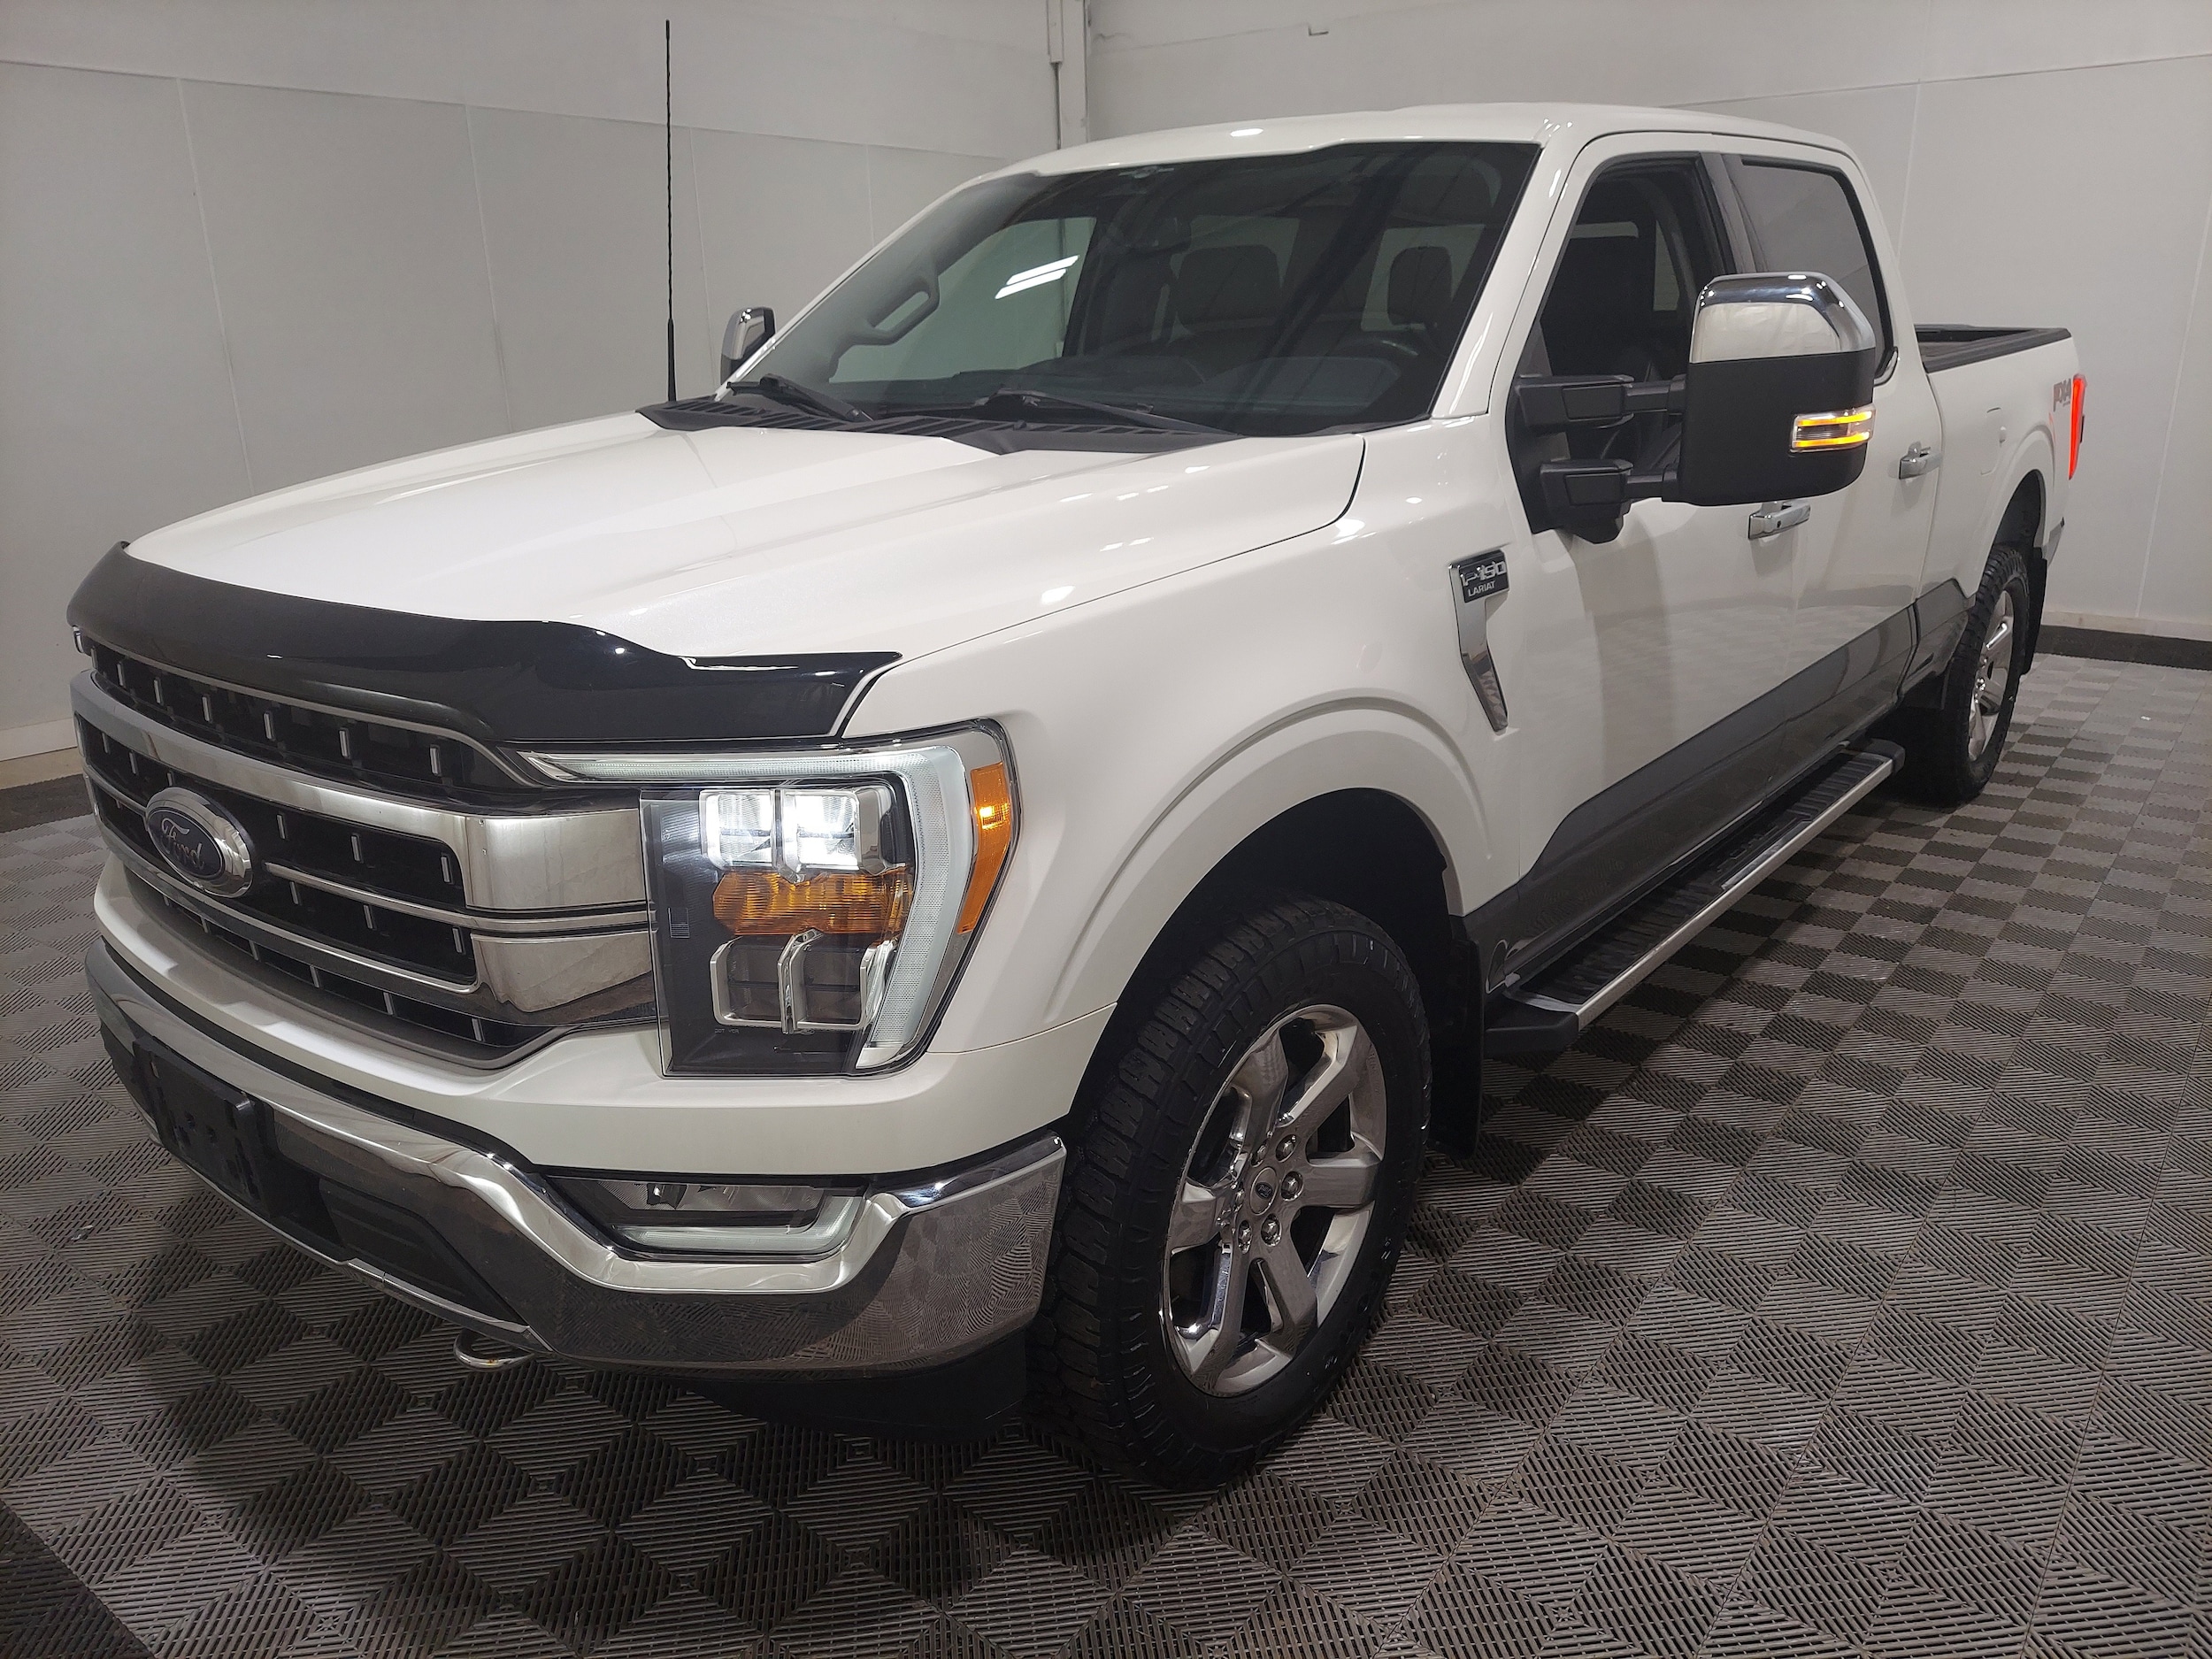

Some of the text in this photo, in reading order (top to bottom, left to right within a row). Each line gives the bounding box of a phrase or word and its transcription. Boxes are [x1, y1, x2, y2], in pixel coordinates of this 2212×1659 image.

[1460, 561, 1507, 586] F-150
[1468, 580, 1495, 596] LARIAT
[161, 817, 204, 871] Ford
